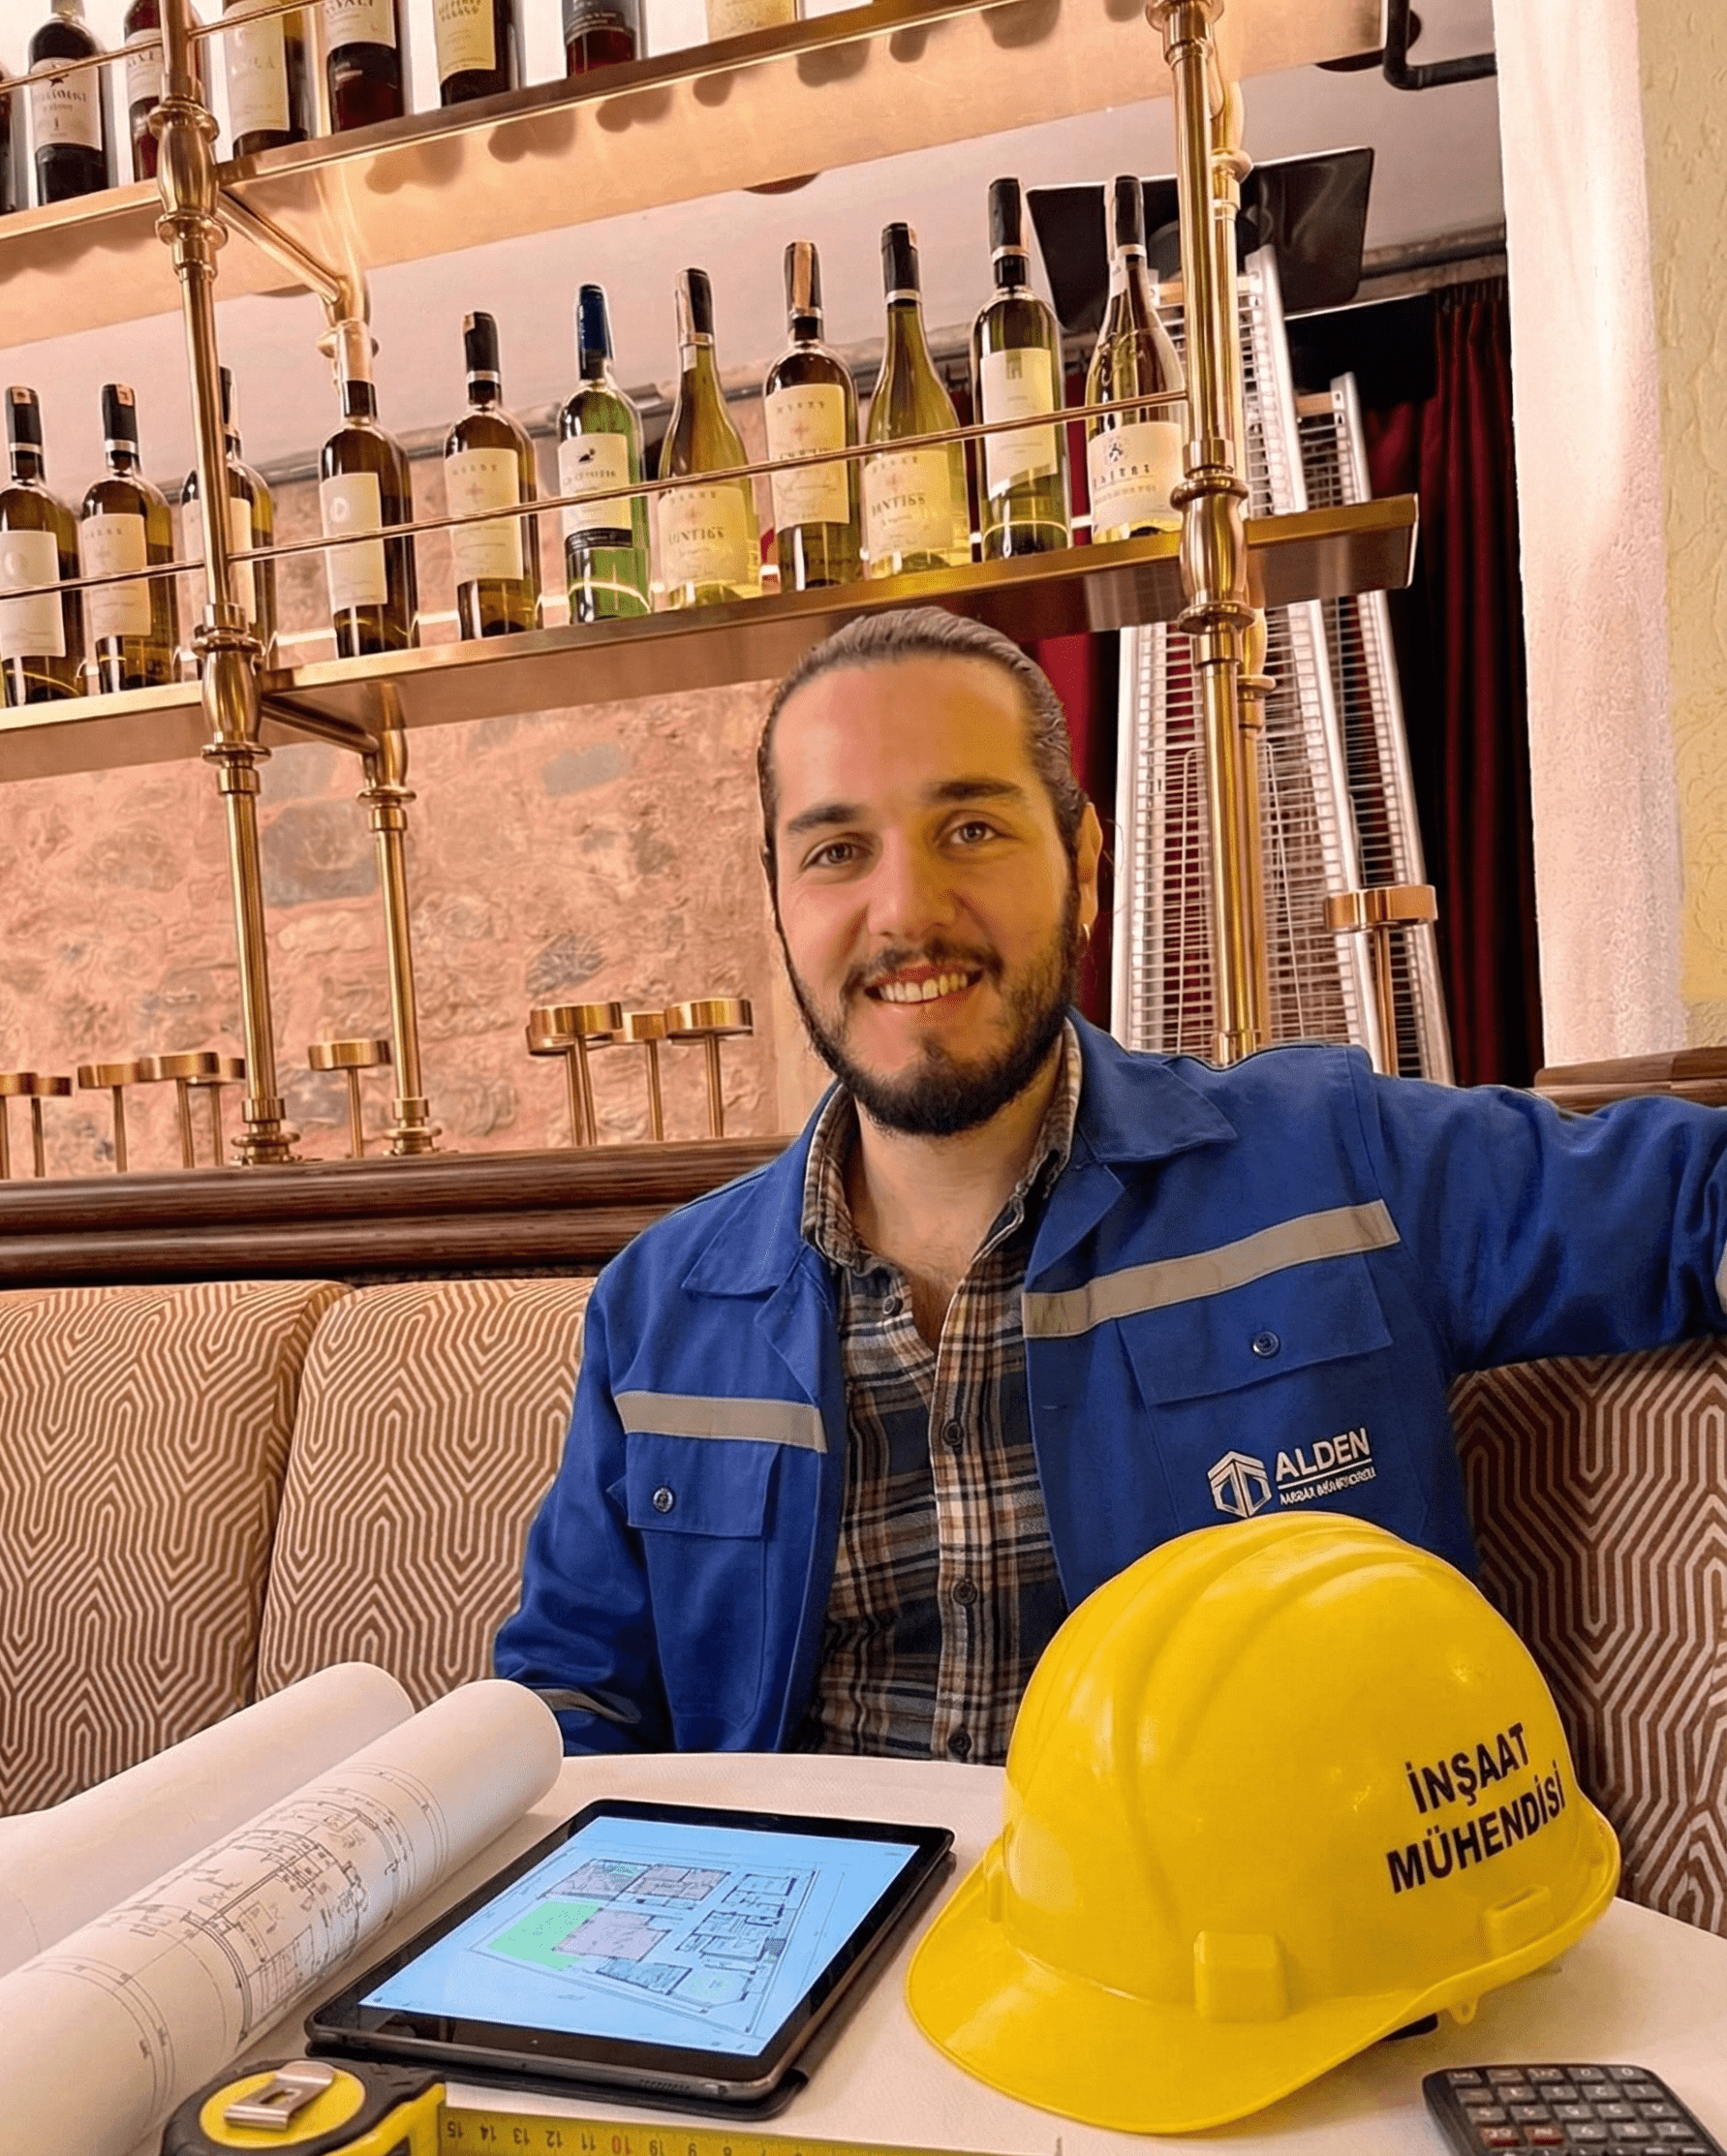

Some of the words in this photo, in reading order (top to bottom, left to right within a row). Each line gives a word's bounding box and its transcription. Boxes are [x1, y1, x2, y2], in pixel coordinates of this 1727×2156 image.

[1276, 1428, 1371, 1482] ALDEN
[1405, 1722, 1529, 1814] İNŞAAT
[1387, 1759, 1565, 1894] MÜHENDİSİ
[447, 2121, 463, 2139] 15
[480, 2126, 497, 2142] 14
[513, 2128, 530, 2145] 13
[545, 2131, 563, 2147] 12
[582, 2134, 596, 2150] 11
[611, 2136, 632, 2155] 10
